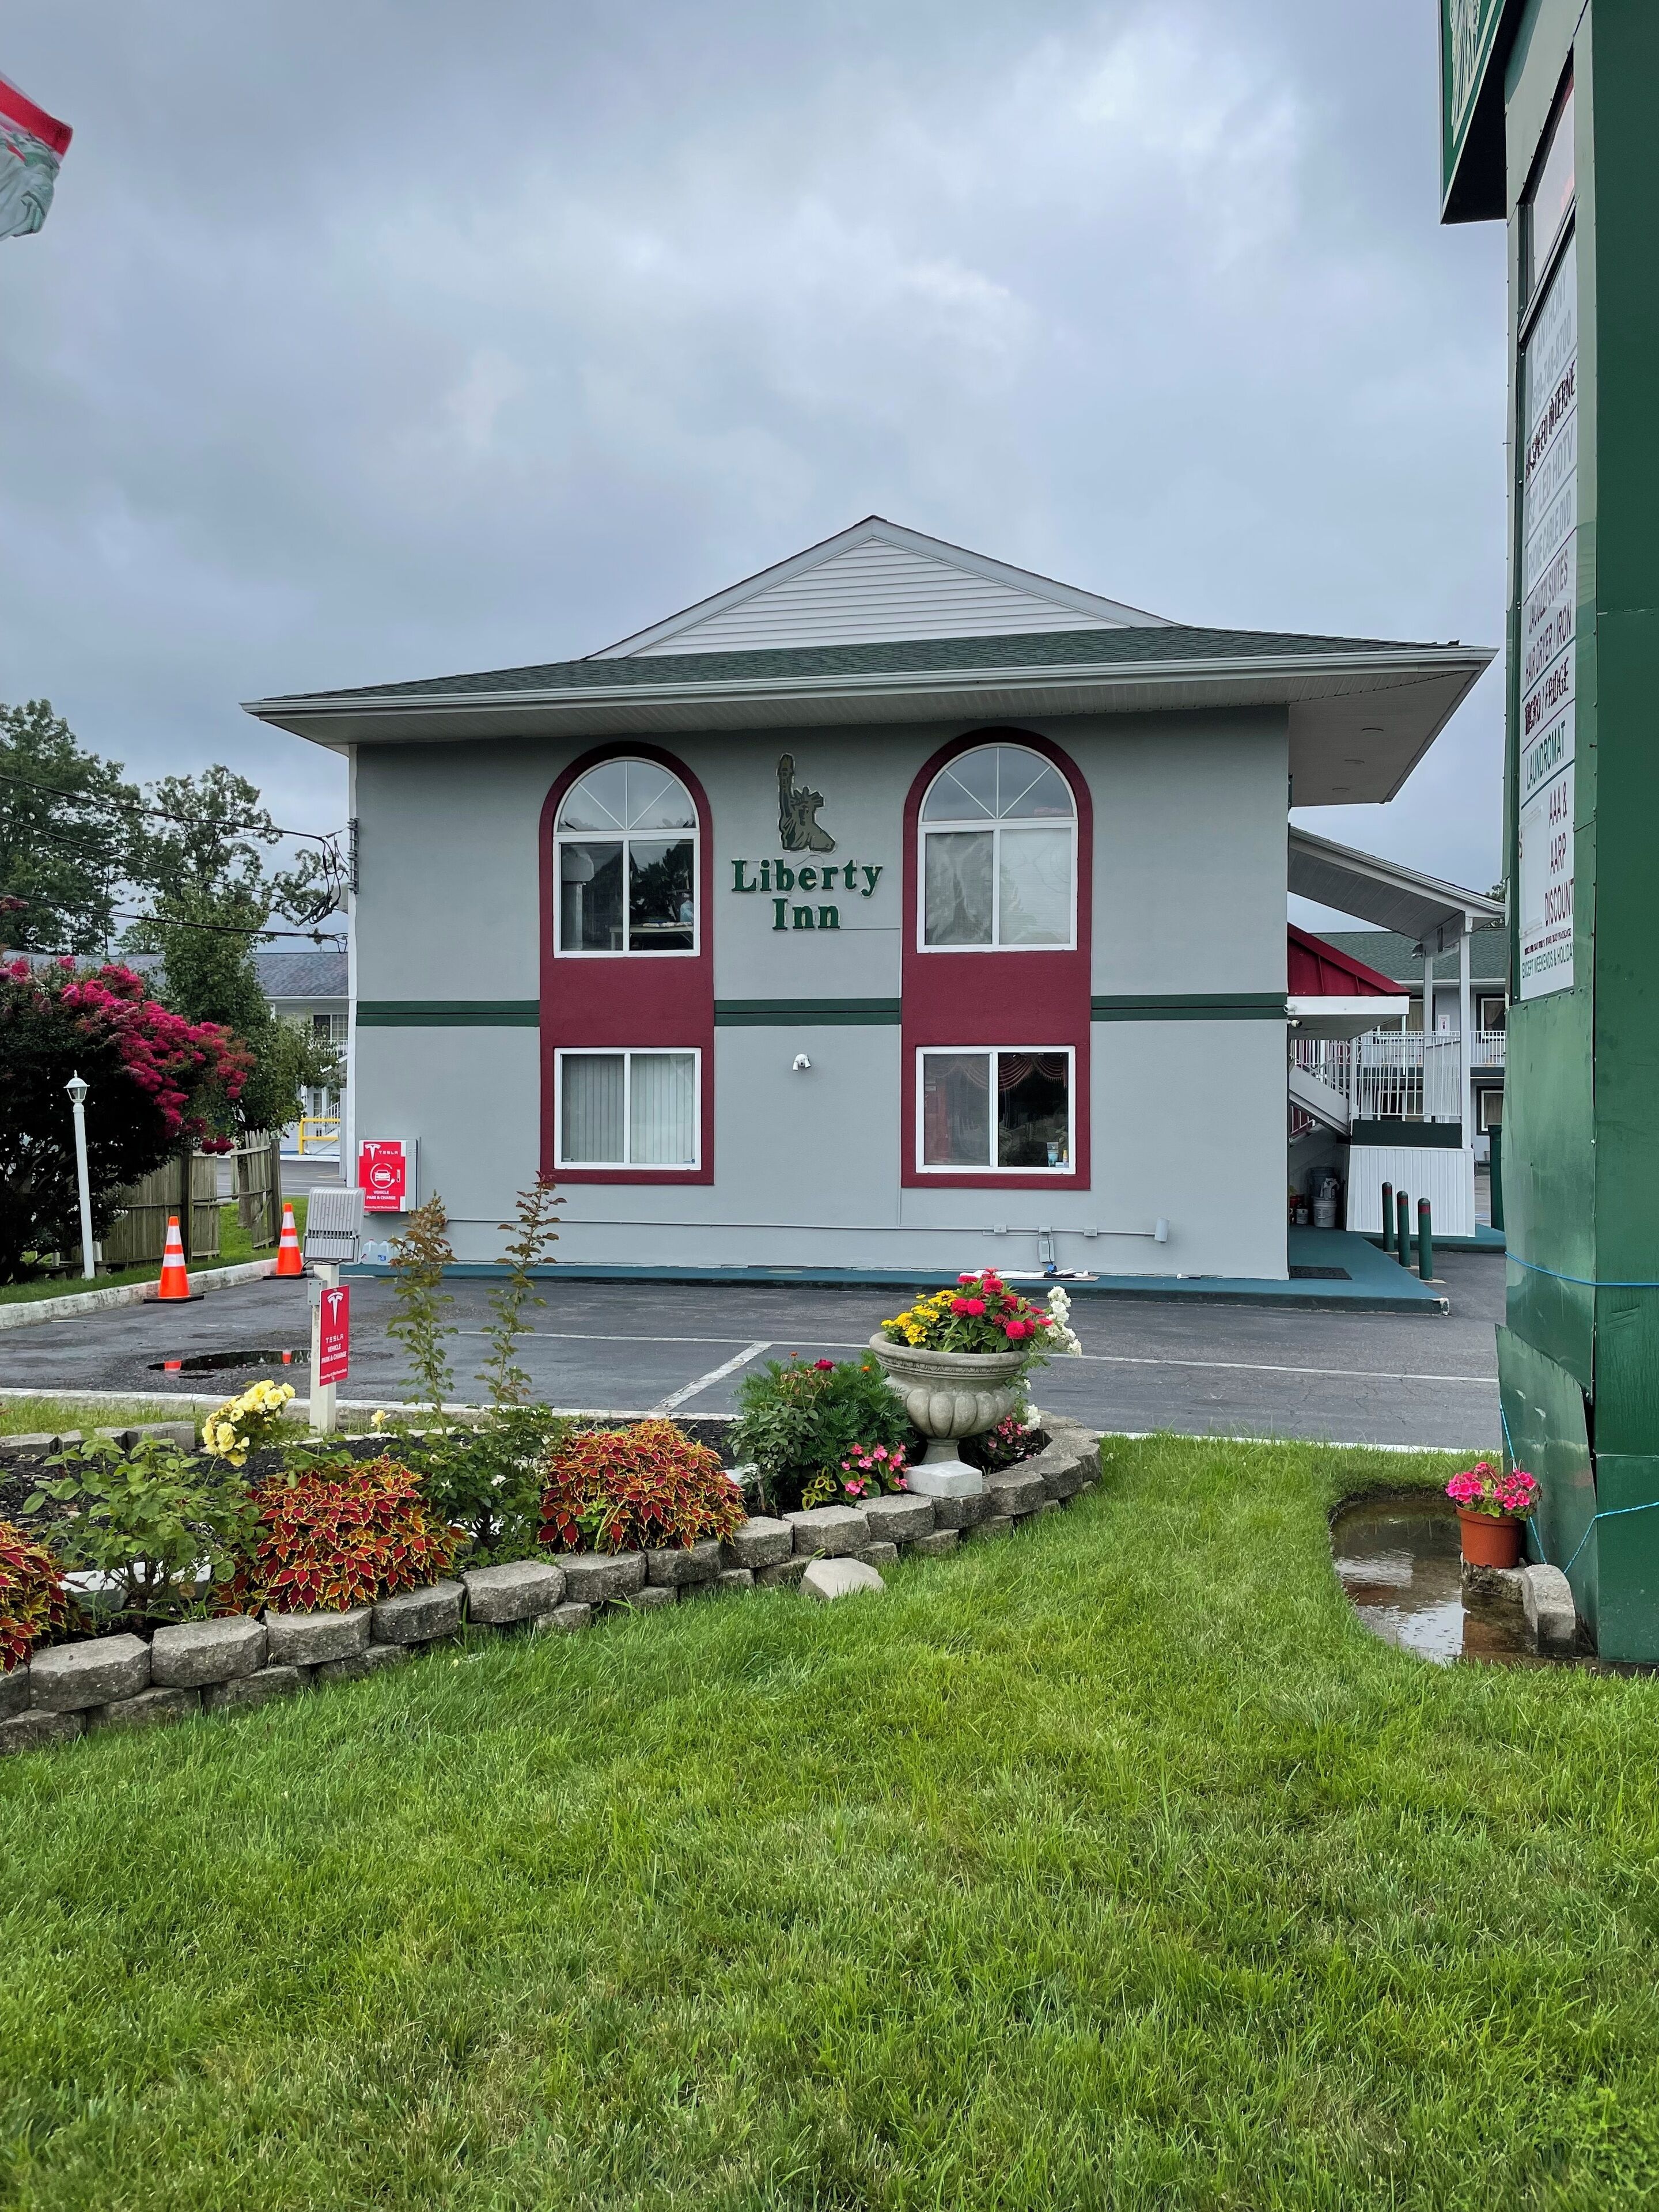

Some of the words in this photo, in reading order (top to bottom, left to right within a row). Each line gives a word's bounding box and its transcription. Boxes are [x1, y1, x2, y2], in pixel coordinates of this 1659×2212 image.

[1539, 462, 1551, 513] LED
[1553, 422, 1573, 488] HDTV
[1543, 506, 1559, 562] CABLE
[1559, 490, 1571, 537] DVD
[1529, 577, 1547, 635] JACUZZI
[1548, 549, 1568, 607] SUITES
[1525, 645, 1536, 688] HAIR
[1536, 623, 1552, 674] DRYER
[1556, 599, 1572, 649] IRON
[1545, 656, 1569, 709] FRIDGE
[1527, 719, 1565, 790] LAUNDROMAT
[1549, 786, 1561, 828] AAA
[1562, 781, 1567, 819] &
[731, 858, 883, 897] Liberty
[1550, 832, 1566, 876] AARP
[772, 898, 840, 930] Inn
[1545, 878, 1574, 927] DISCOUNT
[321, 1355, 330, 1363] PARK
[334, 1351, 347, 1360] CHARGE
[325, 1333, 344, 1343] TESLA
[327, 1343, 341, 1353] VEHICLE
